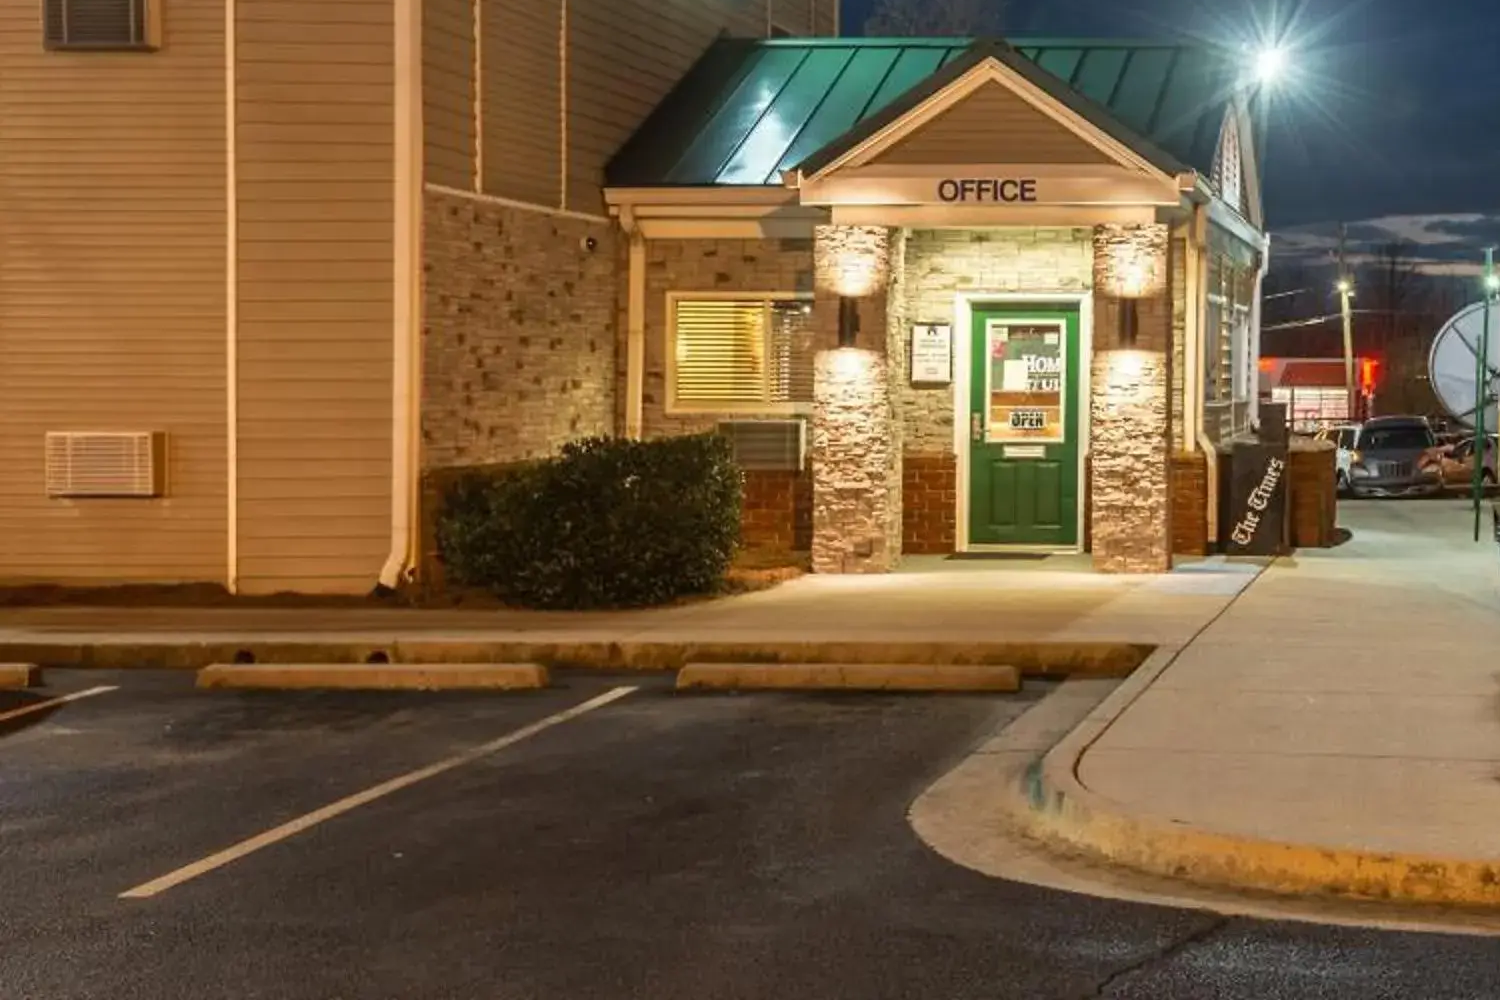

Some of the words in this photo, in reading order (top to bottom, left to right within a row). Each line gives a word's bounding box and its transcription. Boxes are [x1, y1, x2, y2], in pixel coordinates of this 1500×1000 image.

[938, 179, 1037, 202] OFFICE
[1231, 511, 1260, 545] The
[1247, 457, 1284, 511] Times
